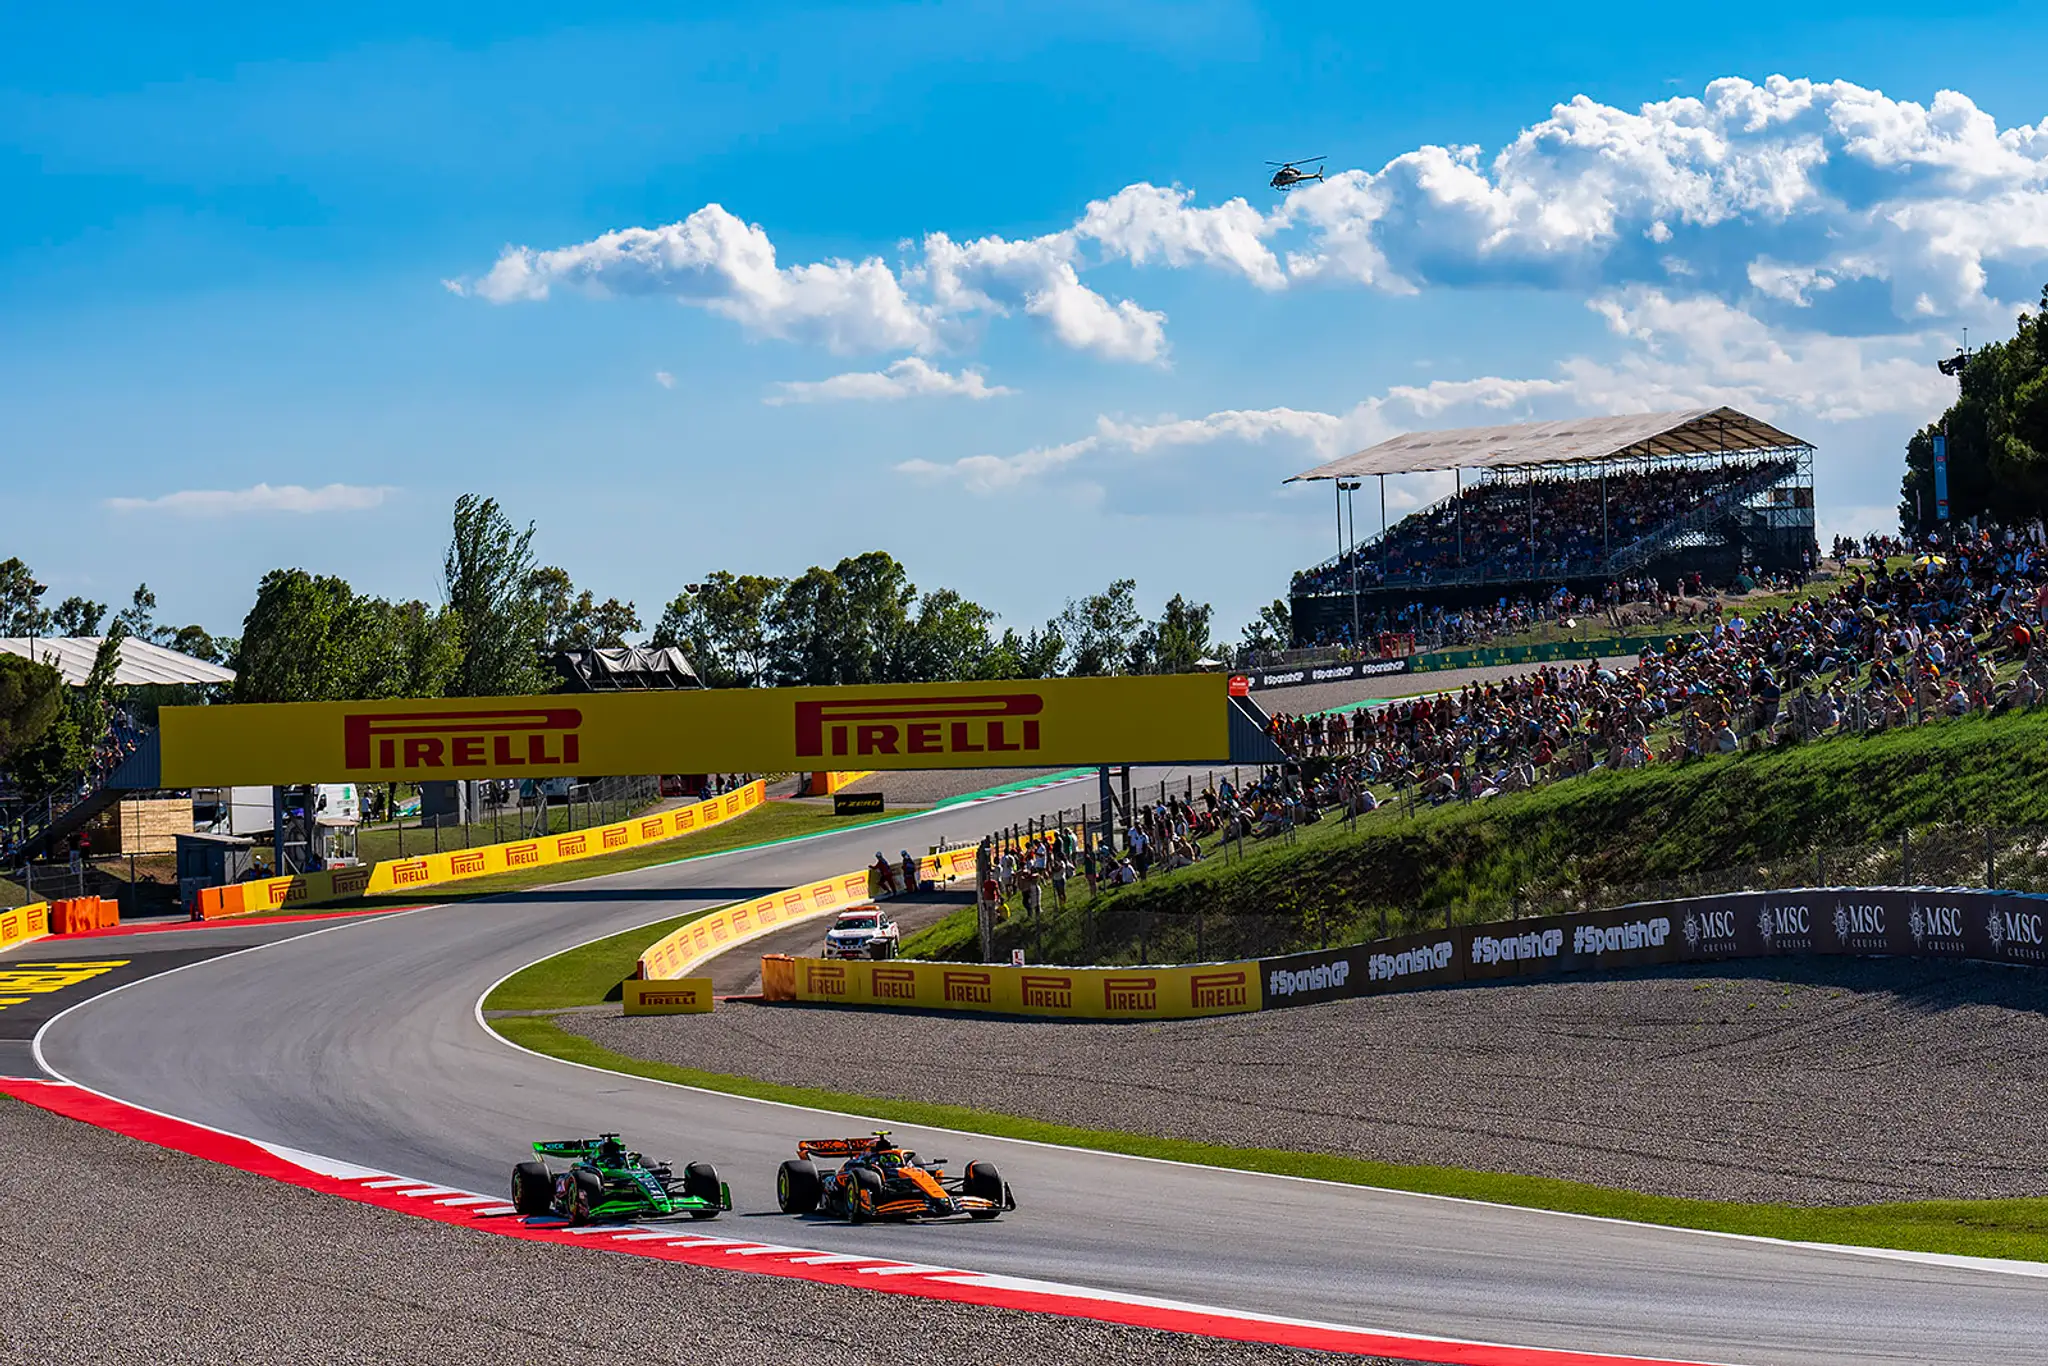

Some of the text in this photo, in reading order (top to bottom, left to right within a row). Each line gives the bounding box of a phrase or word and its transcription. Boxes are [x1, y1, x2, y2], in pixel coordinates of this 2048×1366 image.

[1263, 671, 1304, 686] #SpanishGP
[1312, 666, 1353, 680] #SpanishGP
[1362, 660, 1405, 675] #SpanishGP
[344, 708, 582, 769] PIRELLI
[795, 694, 1044, 757] PIRELLI
[603, 827, 628, 848] PIRELLI
[642, 818, 664, 839] PIRELLI
[506, 843, 538, 866] PIRELLI
[557, 835, 586, 857] PIRELLI
[392, 861, 428, 884] PIRELLI
[450, 852, 485, 875] PIRELLI
[268, 879, 307, 903] PIRELLI
[1700, 911, 1736, 939] MSC
[1775, 906, 1810, 934] MSC
[1849, 905, 1886, 934] MSC
[1926, 907, 1963, 937] MSC
[2005, 912, 2043, 944] MSC
[1472, 929, 1563, 965] #SpanishGP
[1574, 917, 1671, 955] #SpanishGP
[1368, 941, 1453, 981] #SpanishGP
[807, 967, 846, 995] PIRELLI
[872, 968, 915, 999] PIRELLI
[944, 972, 991, 1003] PIRELLI
[1021, 976, 1072, 1008] PIRELLI
[1191, 972, 1247, 1008] PIRELLI
[1270, 960, 1349, 996] #SpanishGP
[639, 991, 696, 1005] PIRELLI
[1104, 978, 1156, 1010] PIRELLI
